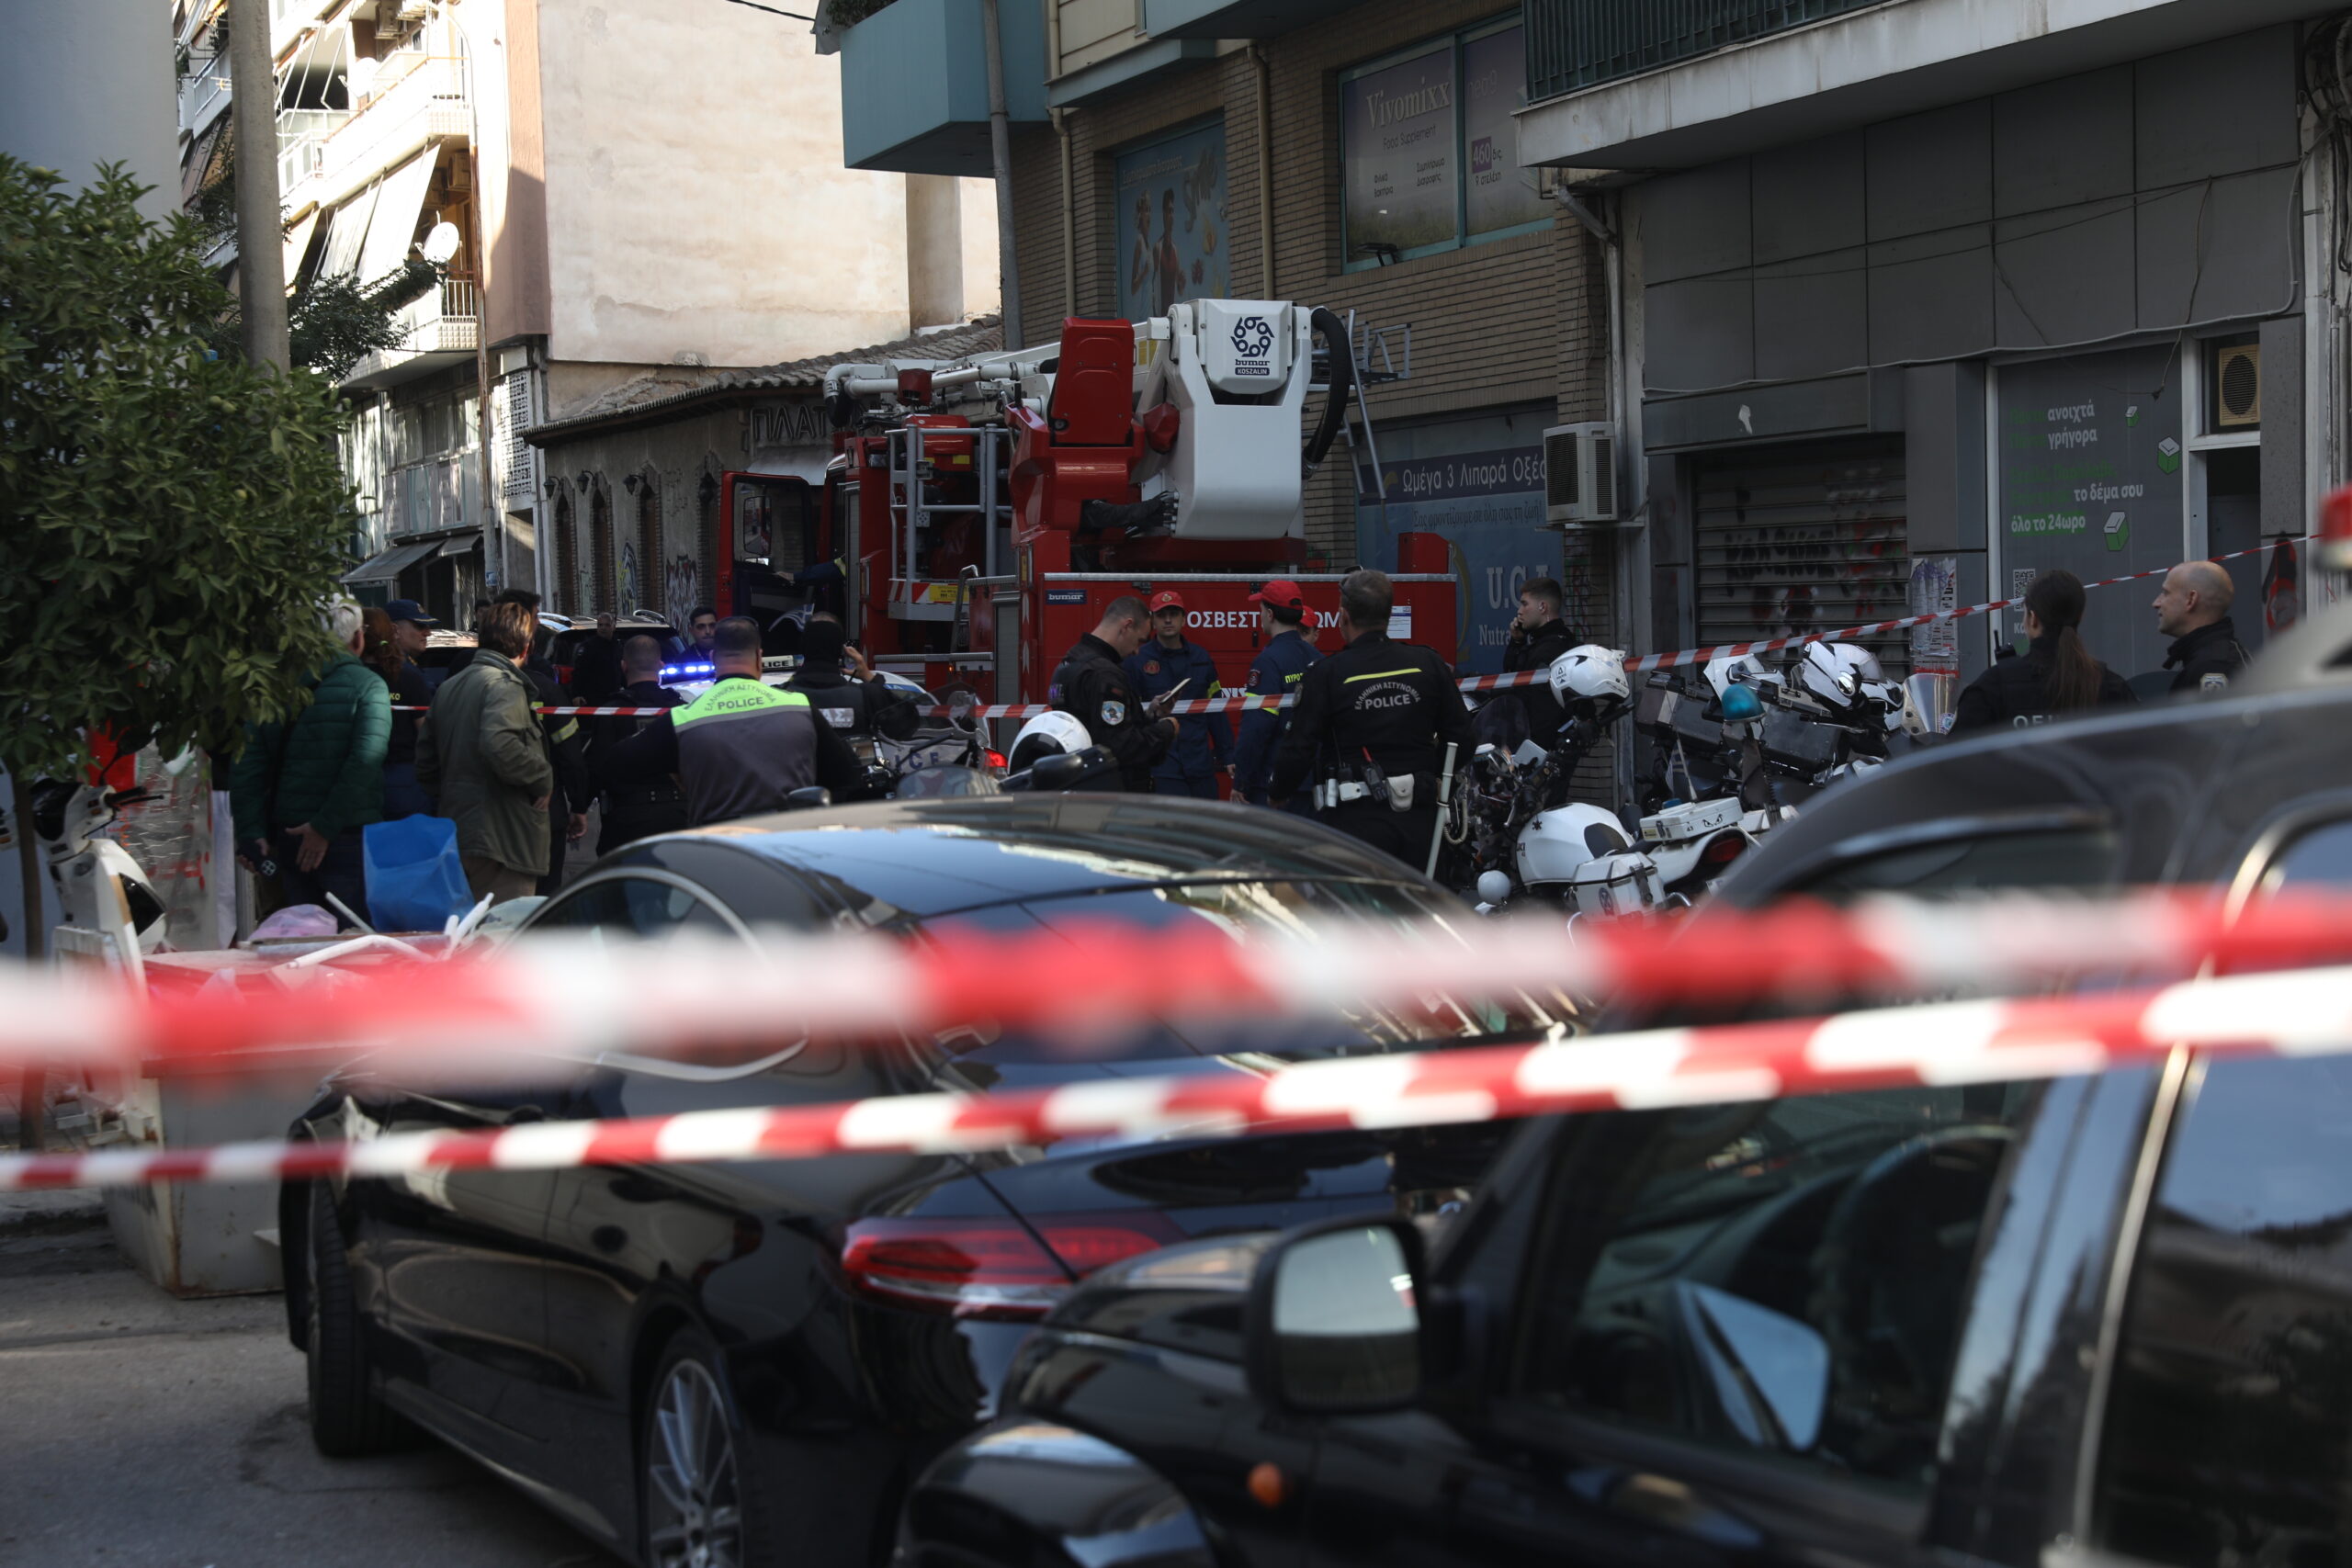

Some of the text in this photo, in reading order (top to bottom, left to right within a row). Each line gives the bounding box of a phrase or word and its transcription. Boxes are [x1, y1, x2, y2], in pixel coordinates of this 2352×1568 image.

[1366, 75, 1451, 130] Vivomixx
[1383, 125, 1437, 151] Food Supplement
[1473, 142, 1491, 166] 460
[2047, 399, 2095, 423] ανοιχτά
[2048, 426, 2098, 450] γρήγορα
[1403, 466, 1442, 496] Ωμέγα
[1446, 464, 1454, 489] 3
[1460, 457, 1507, 489] Λιπαρά
[2074, 488, 2087, 502] το
[2089, 482, 2120, 504] δέμα
[2120, 484, 2143, 498] σου
[2011, 513, 2086, 533] όλο το 24ωρο
[718, 696, 765, 710] POLICE
[1364, 694, 1411, 710] POLICE
